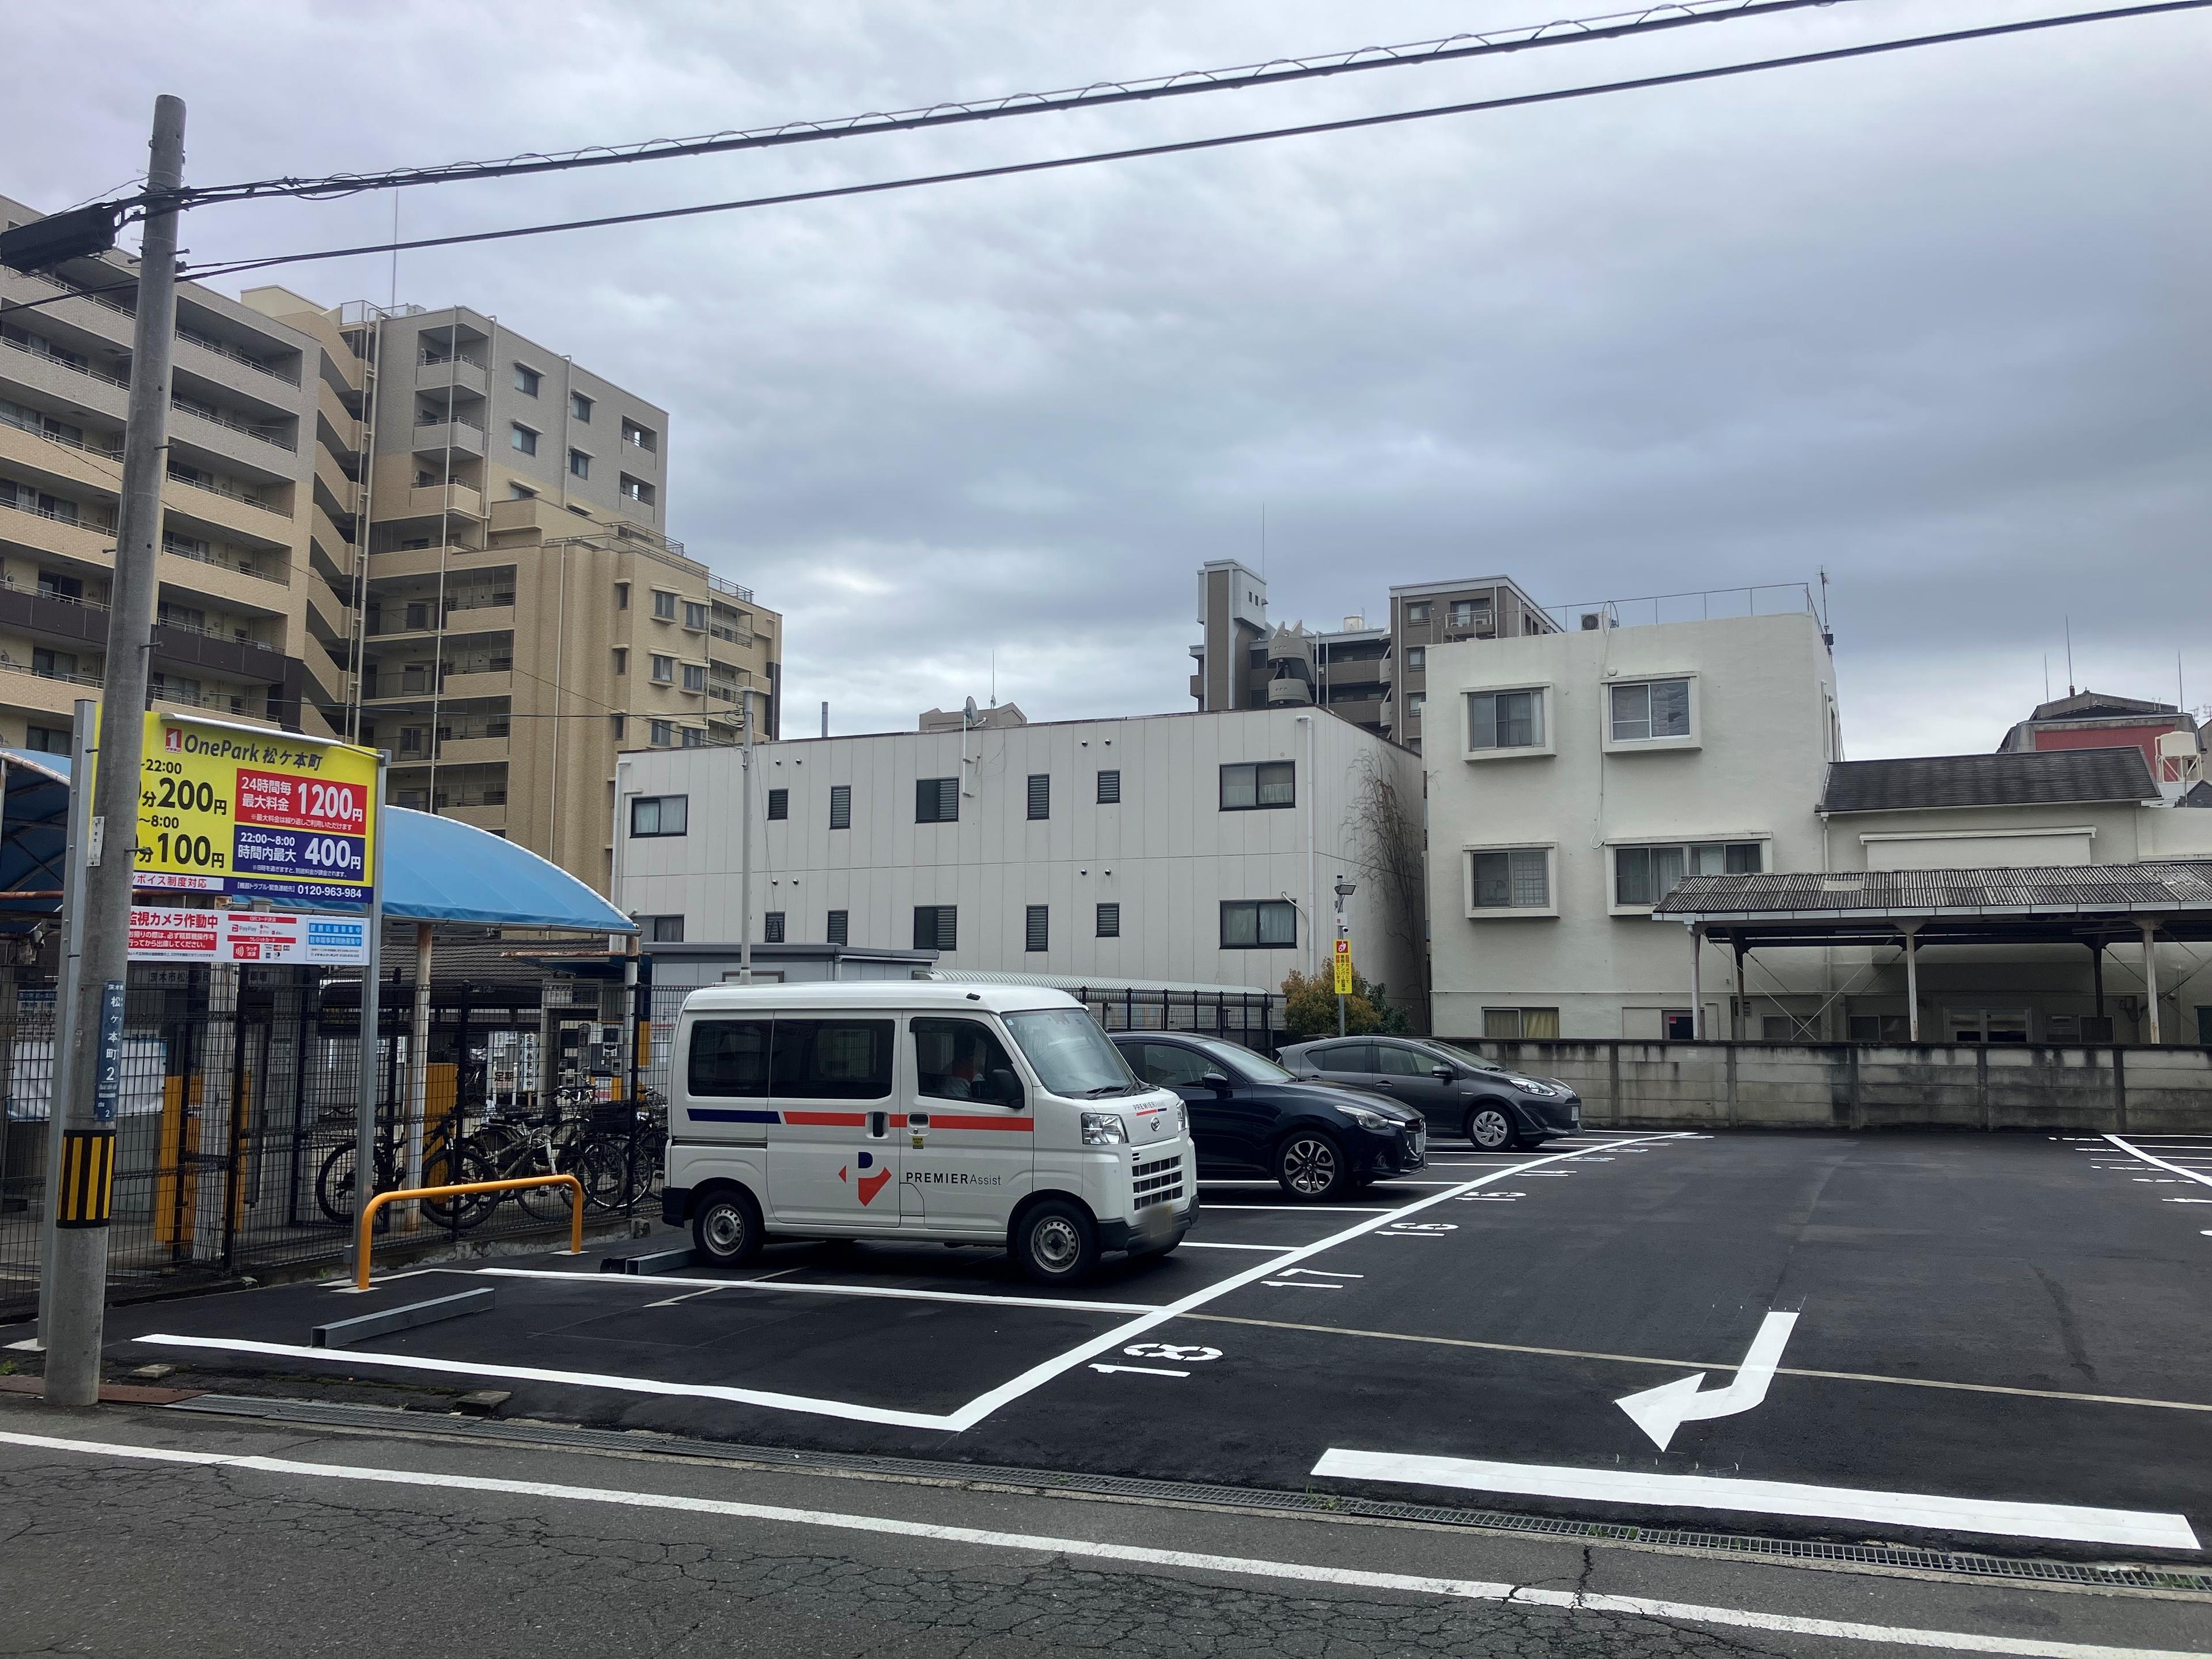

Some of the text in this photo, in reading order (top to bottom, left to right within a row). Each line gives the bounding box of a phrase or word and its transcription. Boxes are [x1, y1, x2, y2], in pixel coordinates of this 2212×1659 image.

[184, 734, 259, 763] OnePark
[241, 777, 292, 796] 24時間毎
[138, 777, 228, 816] 分200円
[242, 793, 290, 812] 最大料金
[298, 783, 363, 823] 1200円
[134, 832, 225, 869] 分100円
[237, 844, 297, 863] 時間内最大
[304, 838, 362, 870] 400円
[133, 873, 207, 889] ボイス制度対応
[297, 884, 362, 899] 0120-963-984
[130, 910, 218, 929] 監視カメラ作動中
[105, 1109, 111, 1118] 2
[1088, 1343, 1224, 1378] 18
